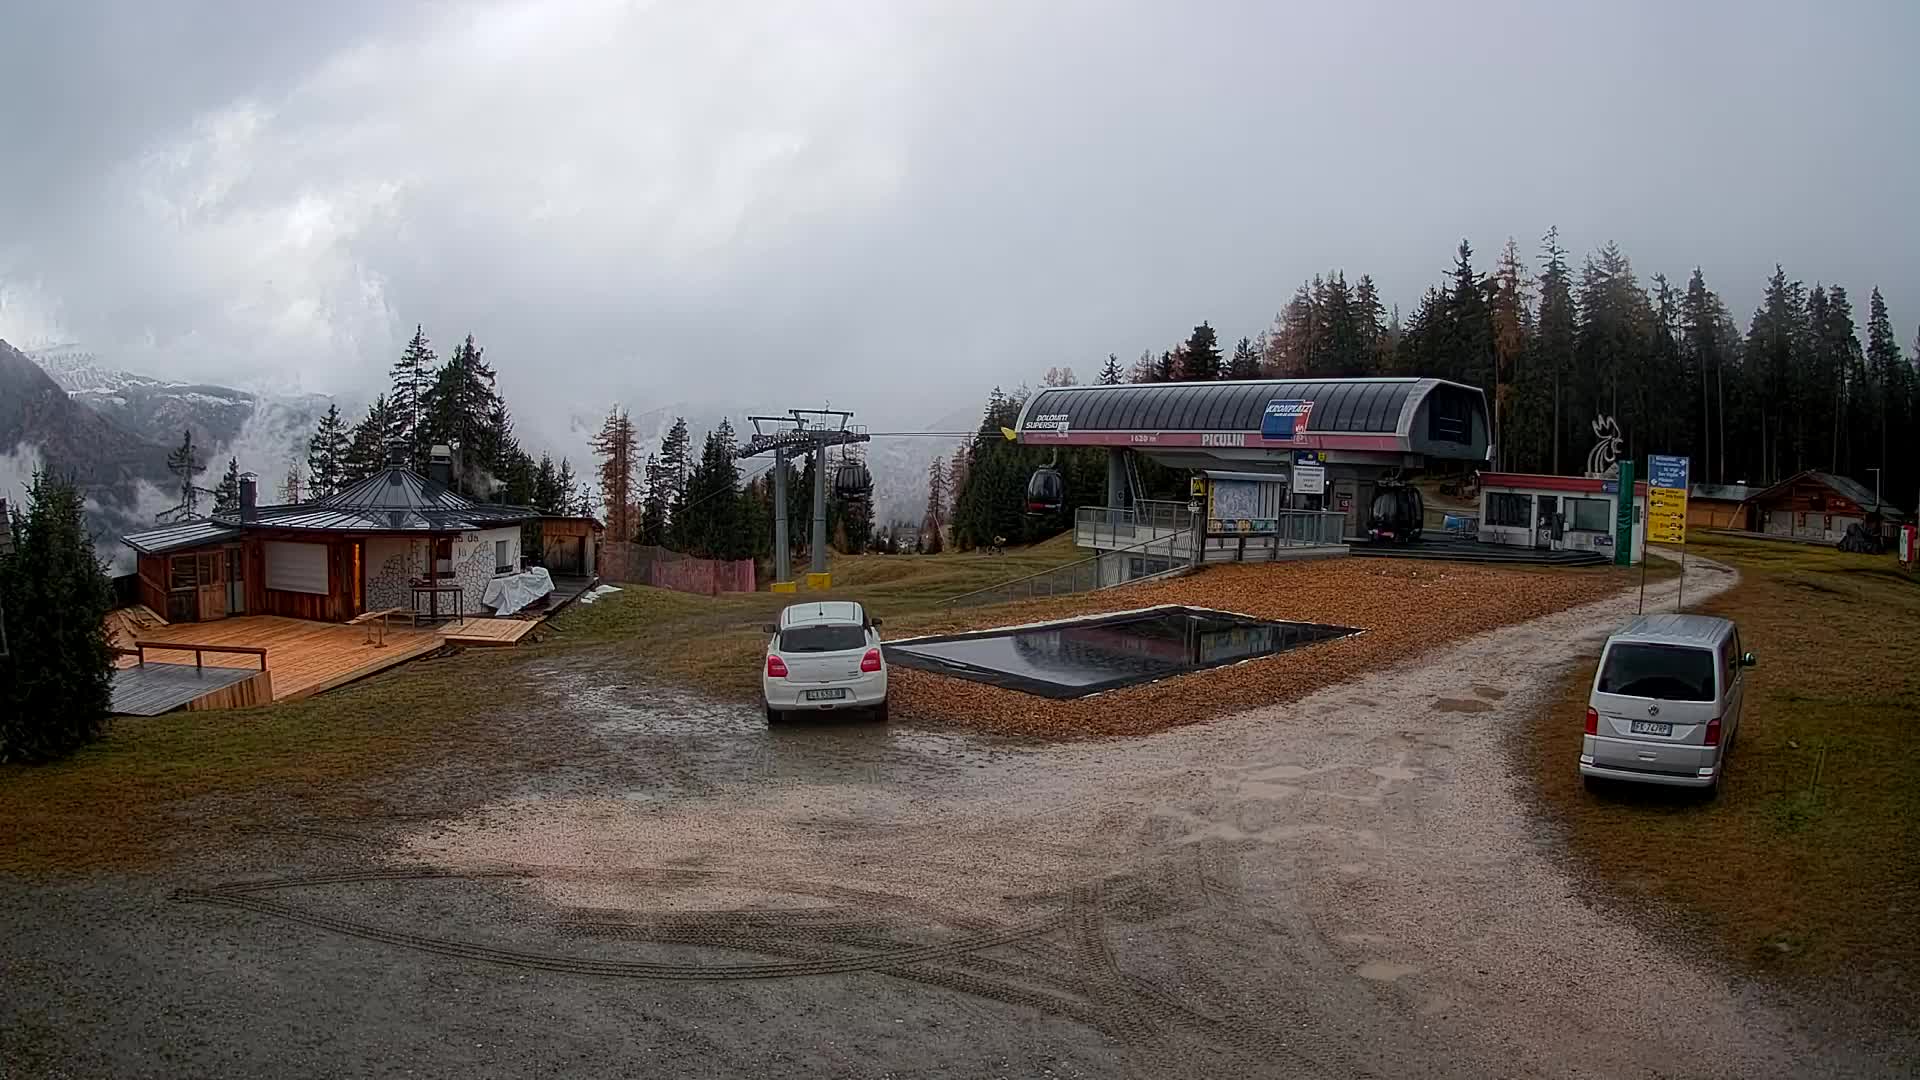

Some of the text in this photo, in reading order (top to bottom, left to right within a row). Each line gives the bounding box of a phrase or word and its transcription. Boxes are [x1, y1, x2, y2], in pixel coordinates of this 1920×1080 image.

[1036, 414, 1068, 422] DOLOMITI
[1025, 422, 1059, 430] SUPERSKI
[1201, 433, 1245, 447] PICULIN
